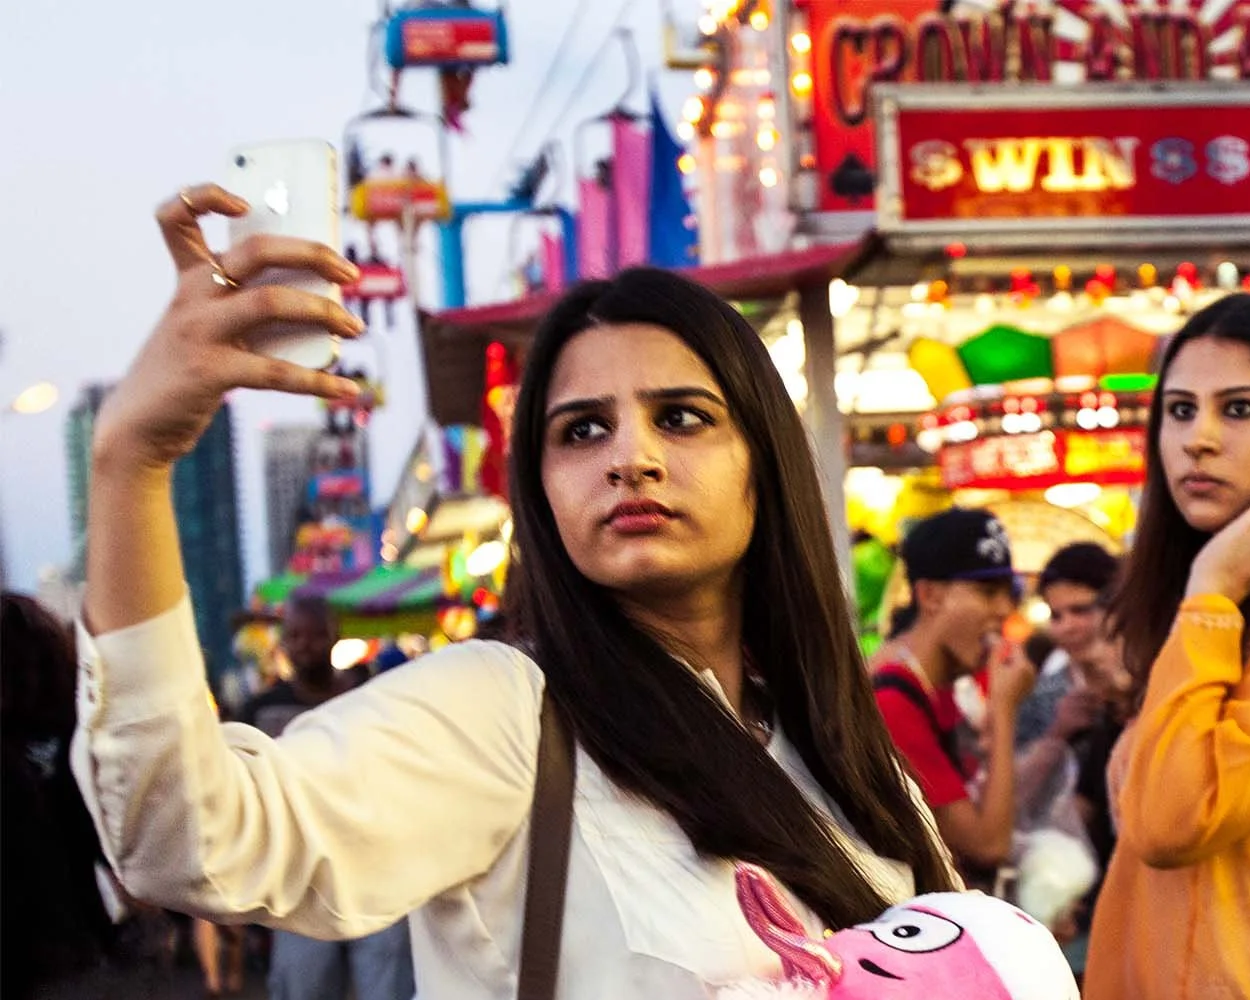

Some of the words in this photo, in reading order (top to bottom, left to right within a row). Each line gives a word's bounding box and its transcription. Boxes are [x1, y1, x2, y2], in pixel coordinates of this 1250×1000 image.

[828, 14, 1056, 125] CROWN
[1084, 12, 1208, 83] AND
[963, 136, 1140, 192] WIN
